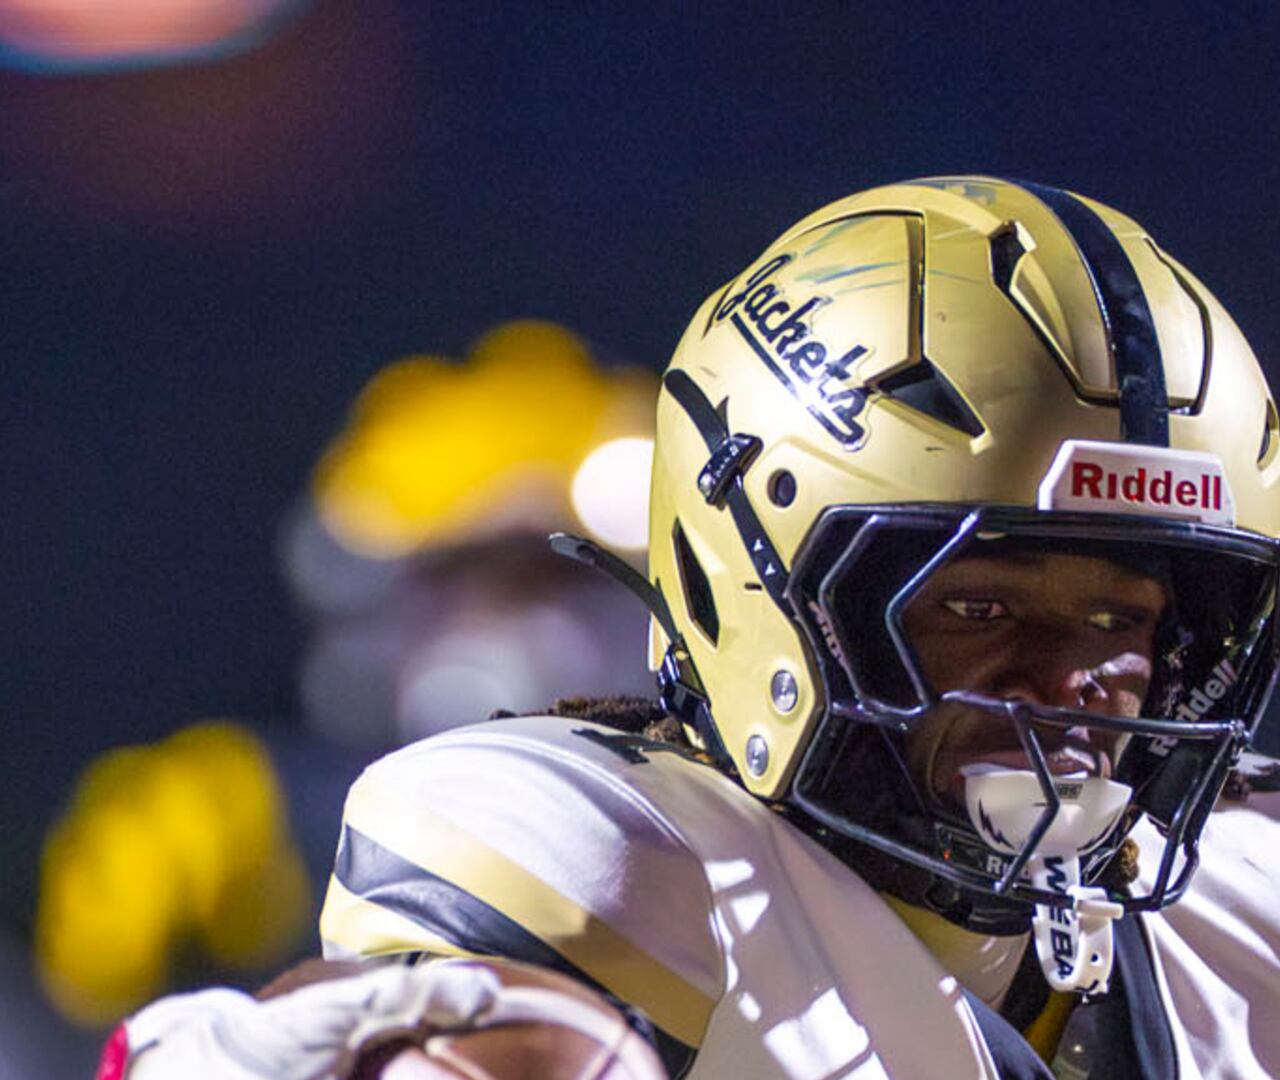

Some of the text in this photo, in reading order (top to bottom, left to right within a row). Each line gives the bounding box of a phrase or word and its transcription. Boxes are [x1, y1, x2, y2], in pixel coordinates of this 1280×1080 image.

[716, 254, 871, 446] Jackets
[1072, 461, 1222, 511] Riddell
[1147, 658, 1239, 758] Rddell
